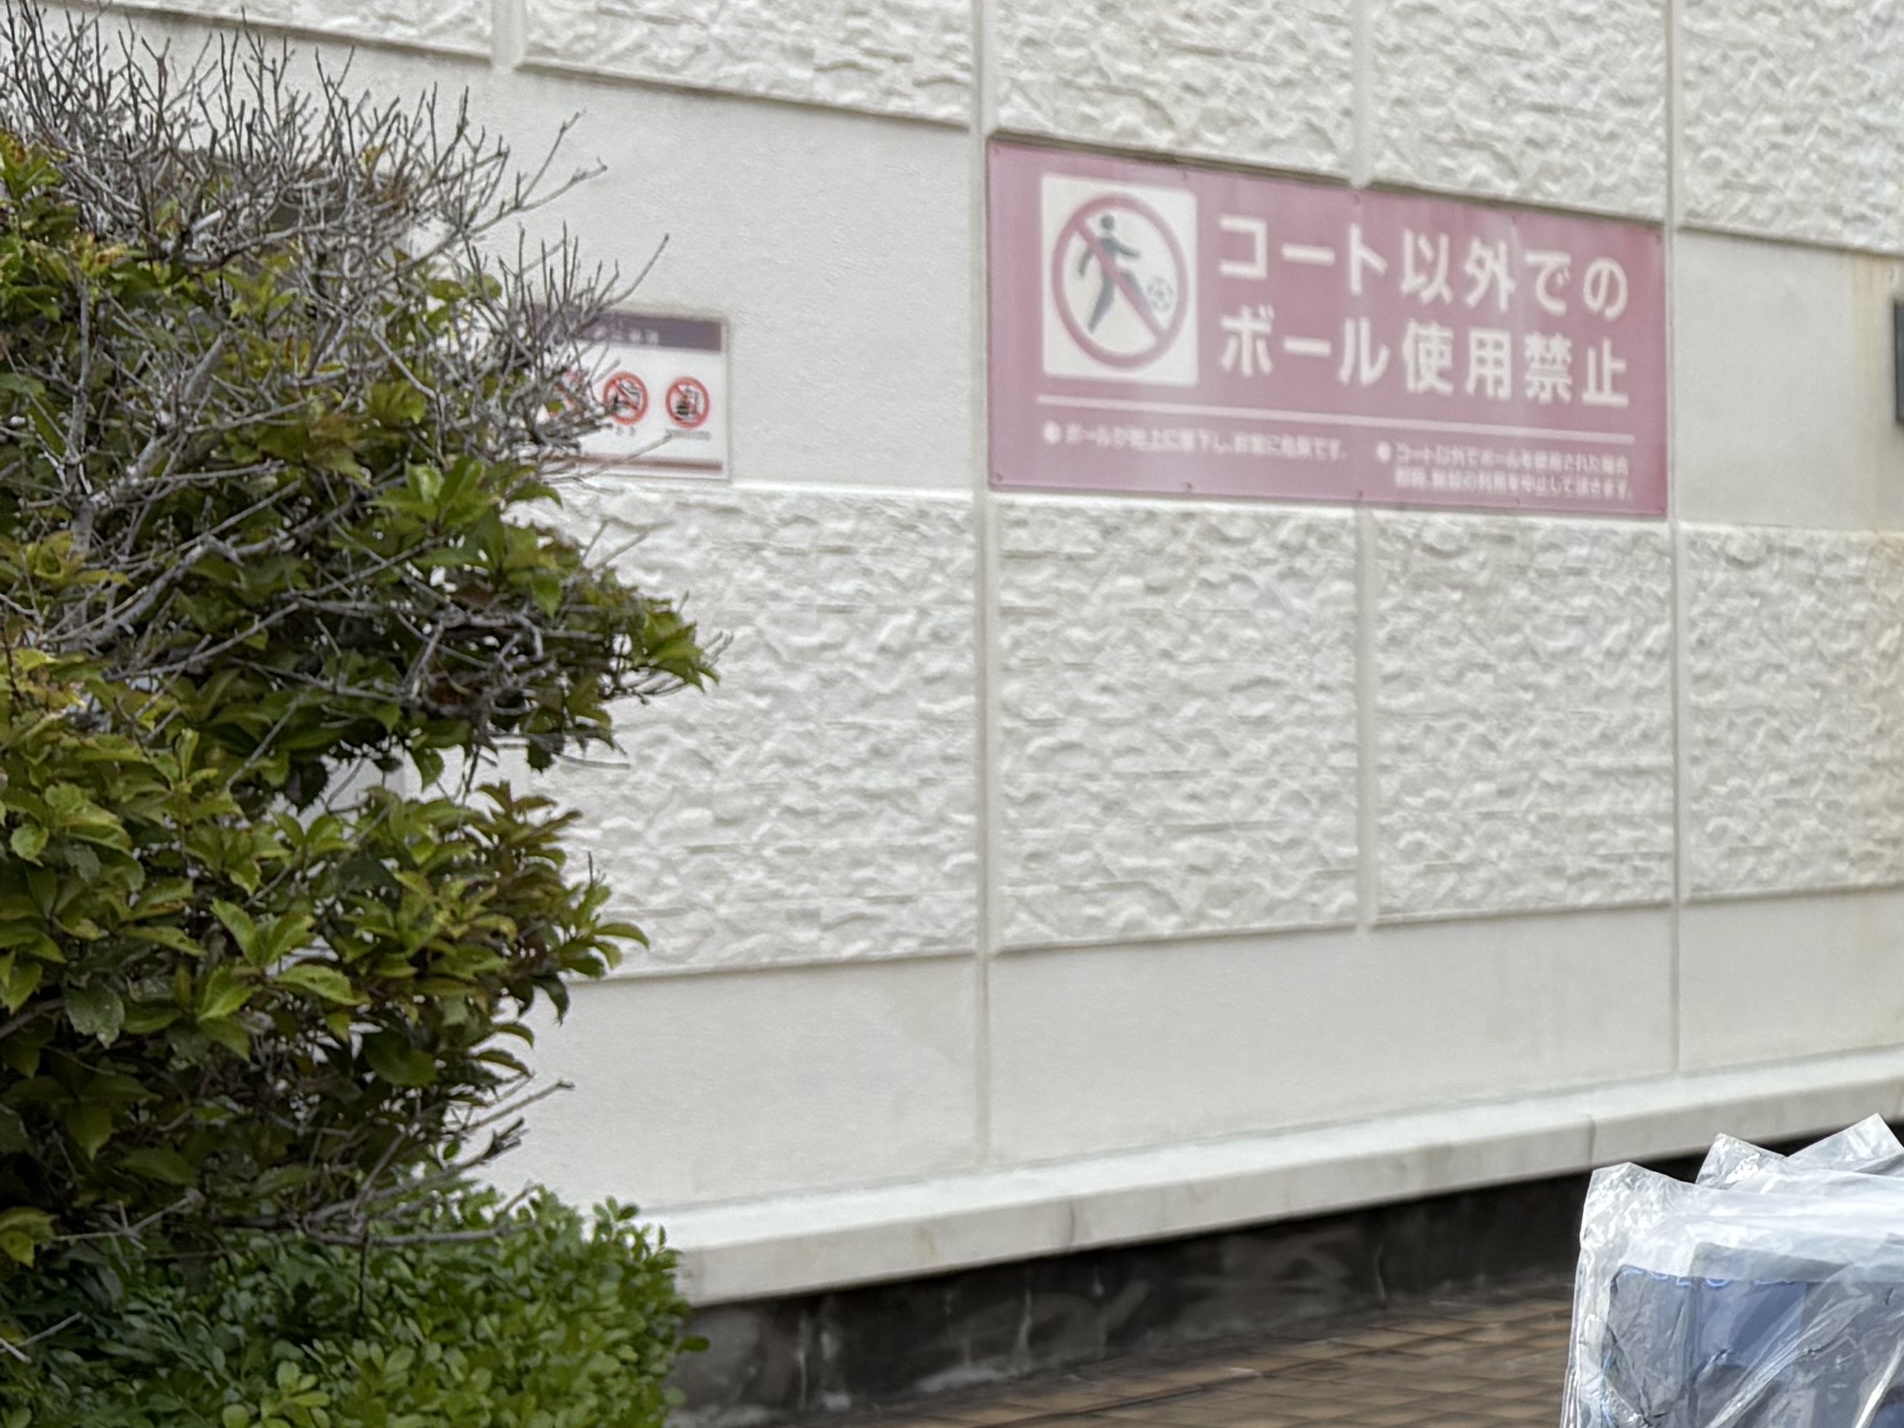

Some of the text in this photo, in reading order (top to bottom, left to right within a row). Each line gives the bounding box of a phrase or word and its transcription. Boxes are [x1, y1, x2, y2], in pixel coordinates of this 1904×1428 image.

[1218, 213, 1629, 321] コート以外での
[1219, 304, 1630, 409] ボール使用禁止
